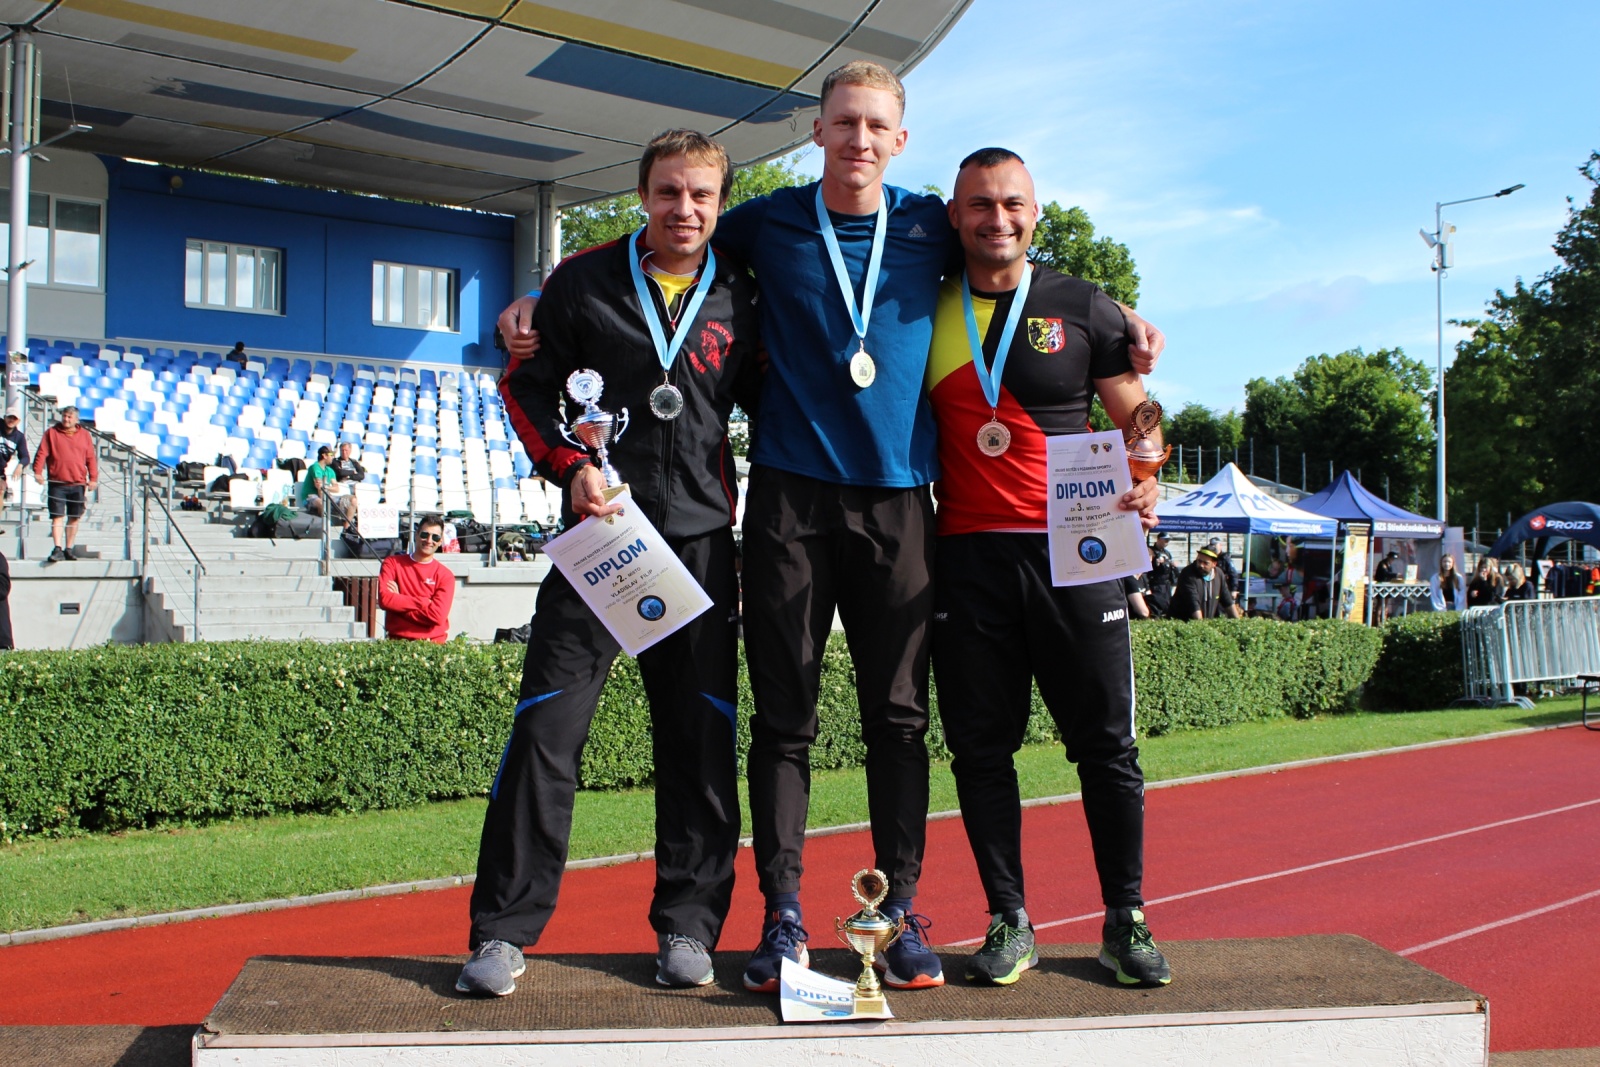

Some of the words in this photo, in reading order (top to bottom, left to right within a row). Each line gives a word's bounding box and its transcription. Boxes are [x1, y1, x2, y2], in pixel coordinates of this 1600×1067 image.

[1056, 479, 1116, 500] DIPLOM
[1175, 490, 1233, 508] 211
[1077, 503, 1084, 511] 3.
[1086, 512, 1111, 521] VIKTORA
[1546, 520, 1594, 530] PROIZS
[583, 538, 648, 587] DIPLOM
[611, 579, 638, 598] VLADISLAV
[640, 569, 652, 580] FILIP
[1102, 609, 1124, 622] JAKO
[796, 988, 850, 1002] DIPLO
